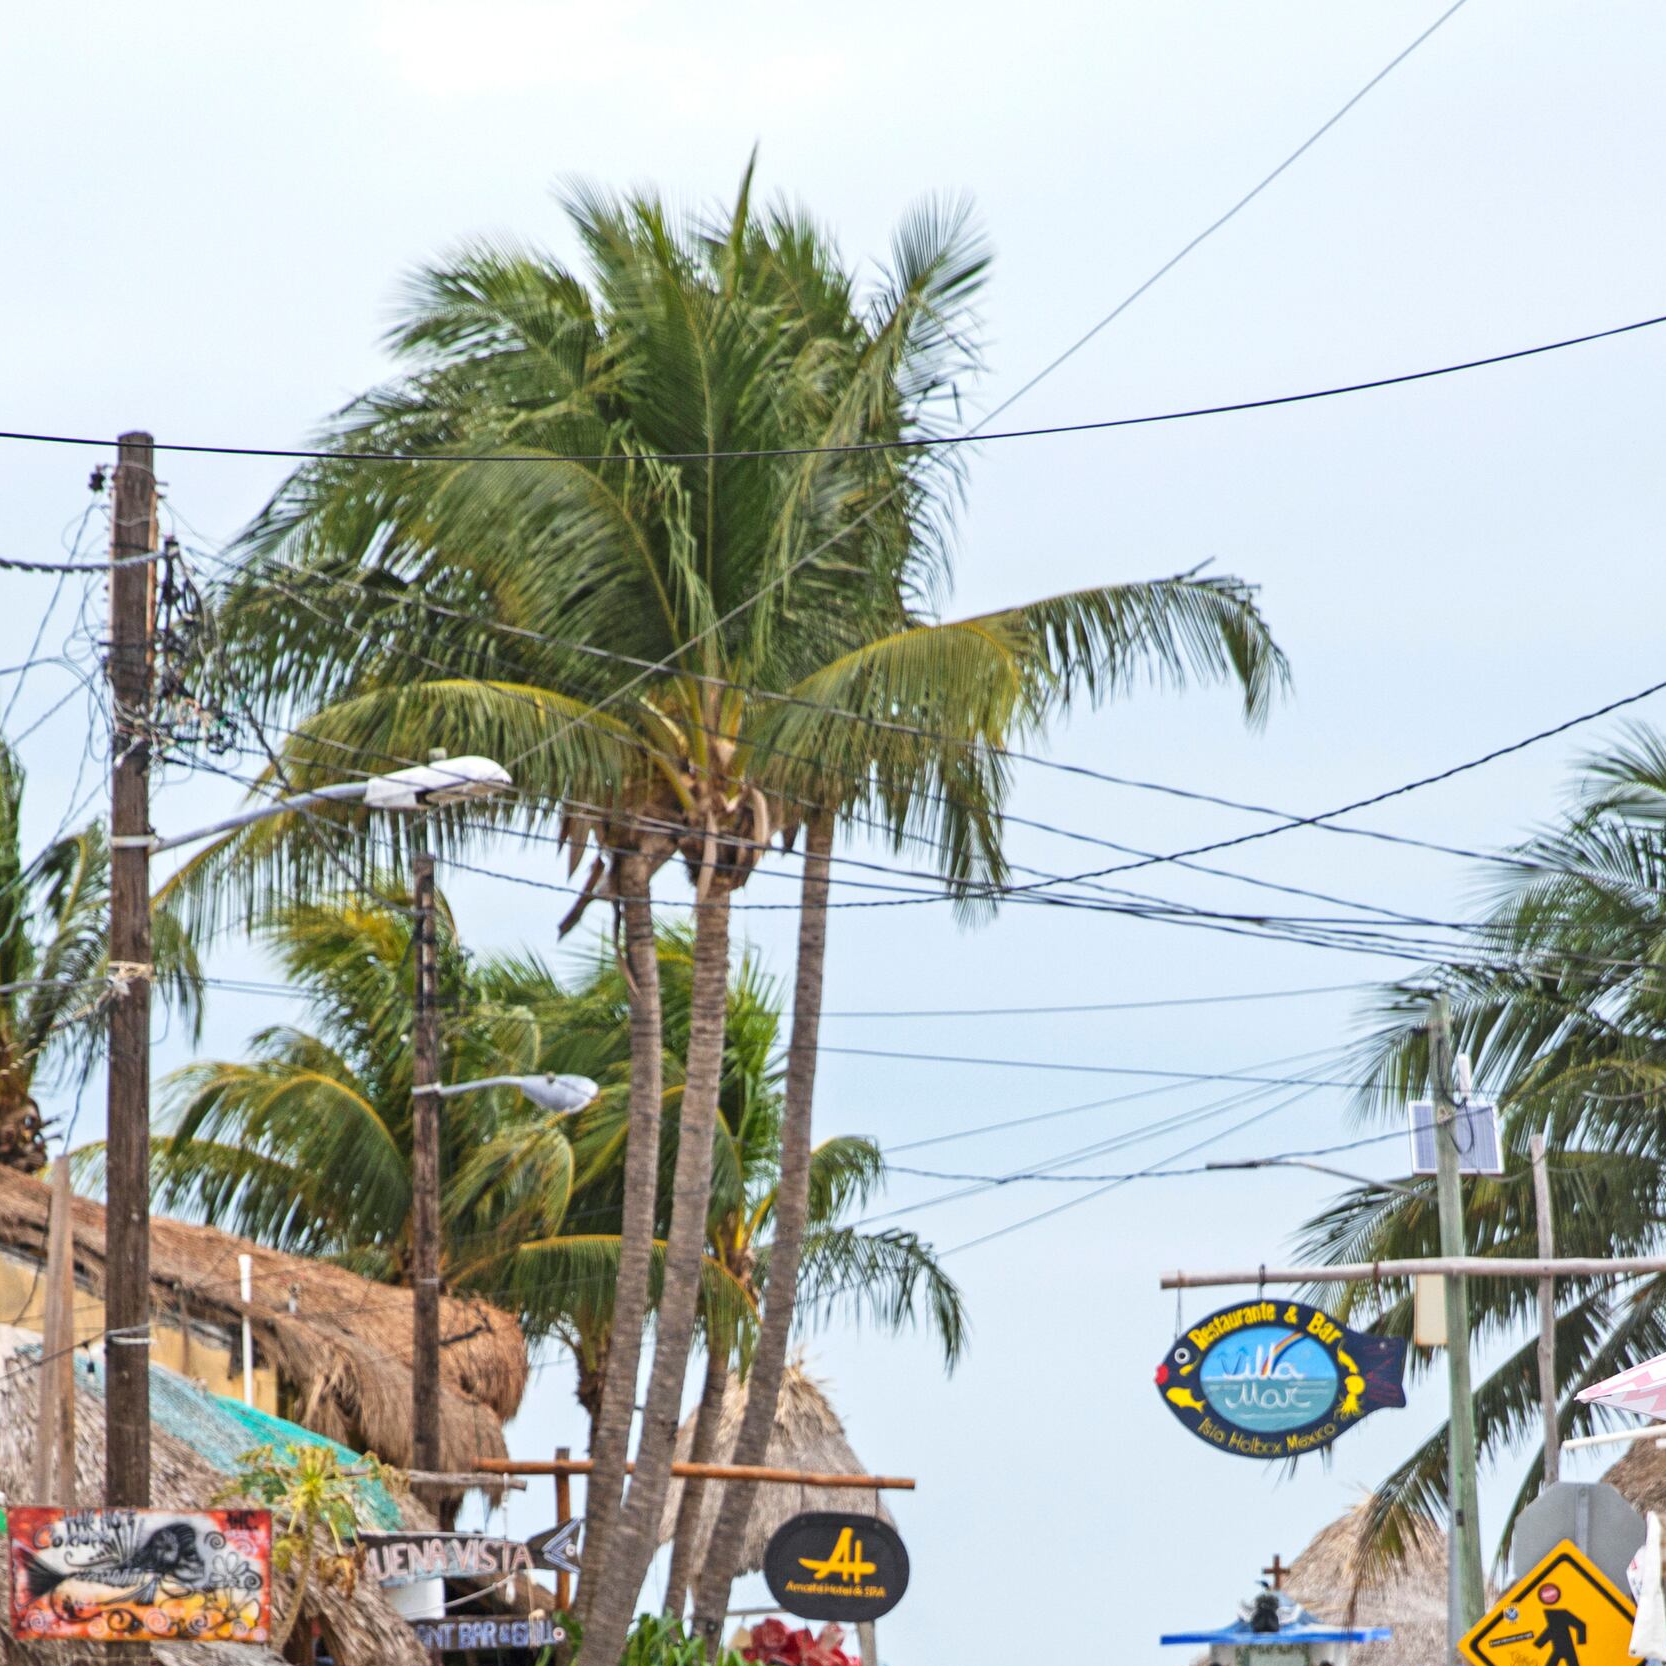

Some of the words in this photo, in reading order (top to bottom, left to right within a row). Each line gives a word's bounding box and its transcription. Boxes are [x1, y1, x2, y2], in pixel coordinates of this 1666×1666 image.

[1187, 1301, 1277, 1351] Restaurante
[1283, 1305, 1298, 1324] &
[1306, 1311, 1344, 1344] Bar
[1225, 1383, 1311, 1409] Mar
[1197, 1416, 1226, 1444] Isla
[1228, 1431, 1283, 1455] Holbox
[450, 1537, 535, 1574] VISTA
[458, 1620, 497, 1649] BAR
